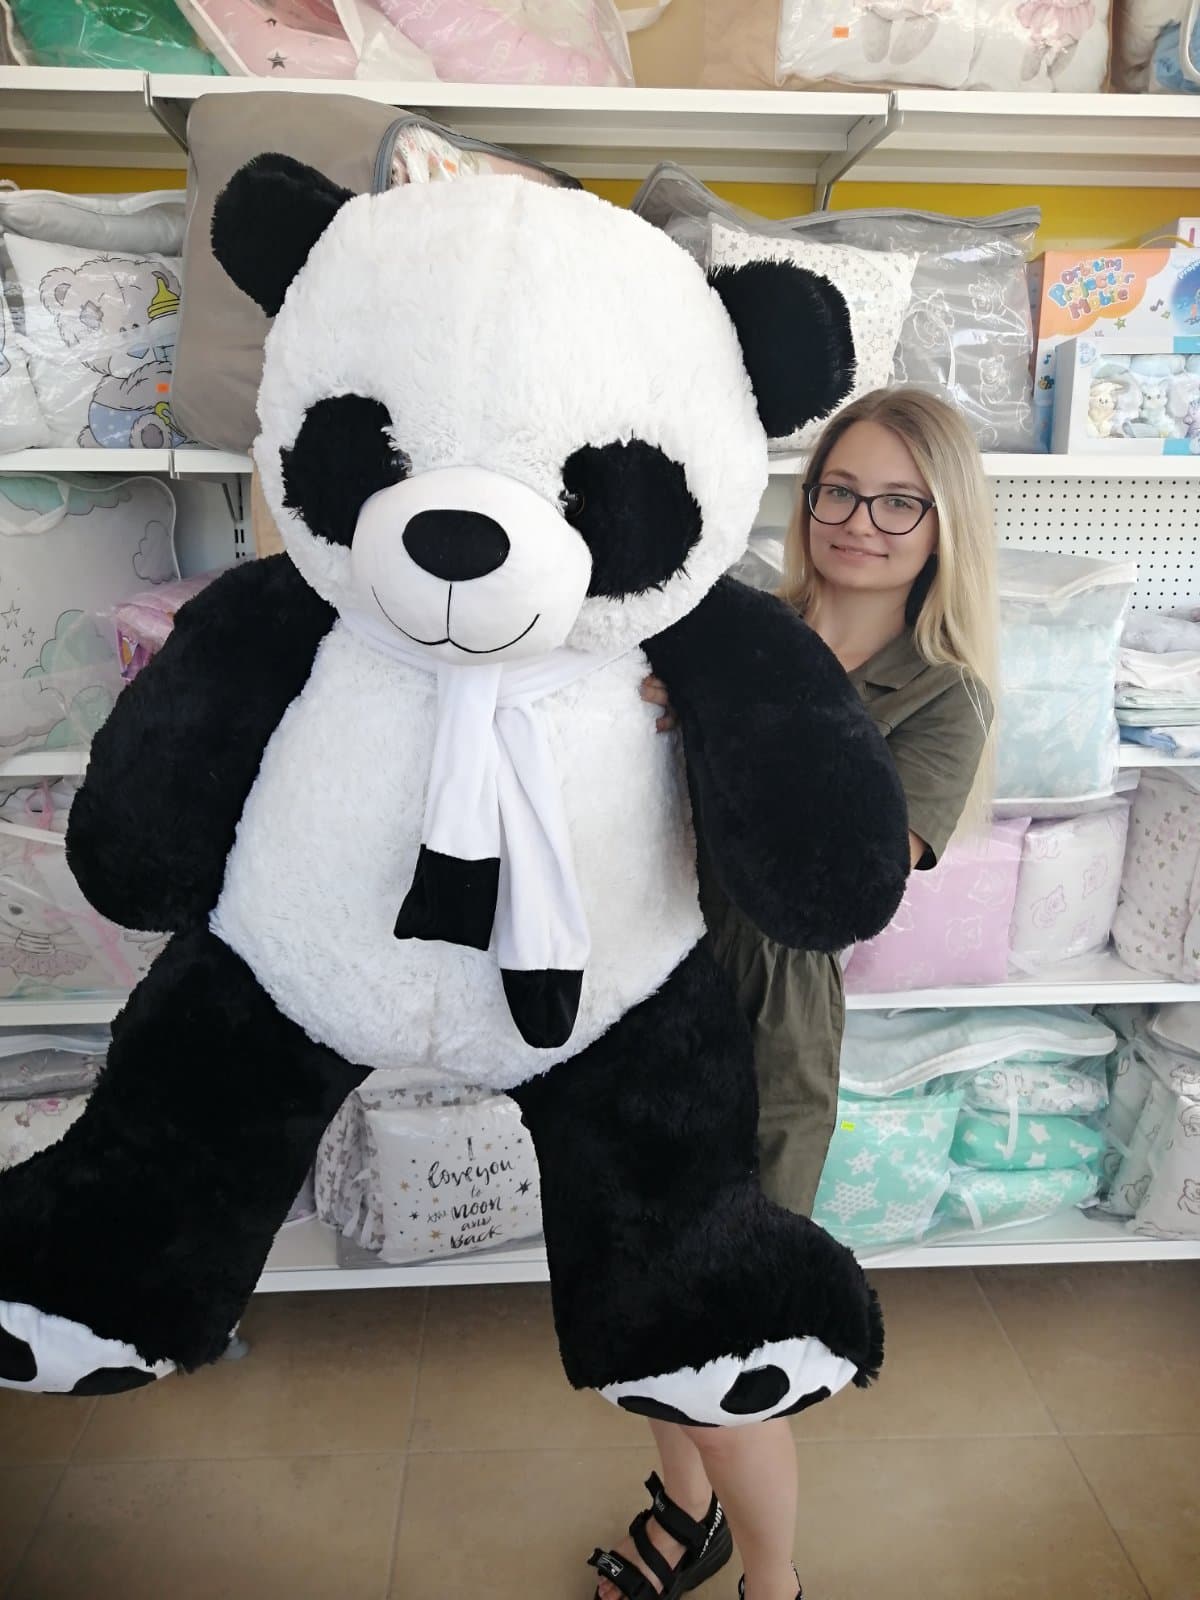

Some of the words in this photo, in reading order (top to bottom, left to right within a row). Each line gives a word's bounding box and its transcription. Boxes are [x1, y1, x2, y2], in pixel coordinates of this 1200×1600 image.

[1061, 258, 1122, 285] Orbiting
[1048, 271, 1135, 307] Projector
[1069, 287, 1129, 319] Mobile
